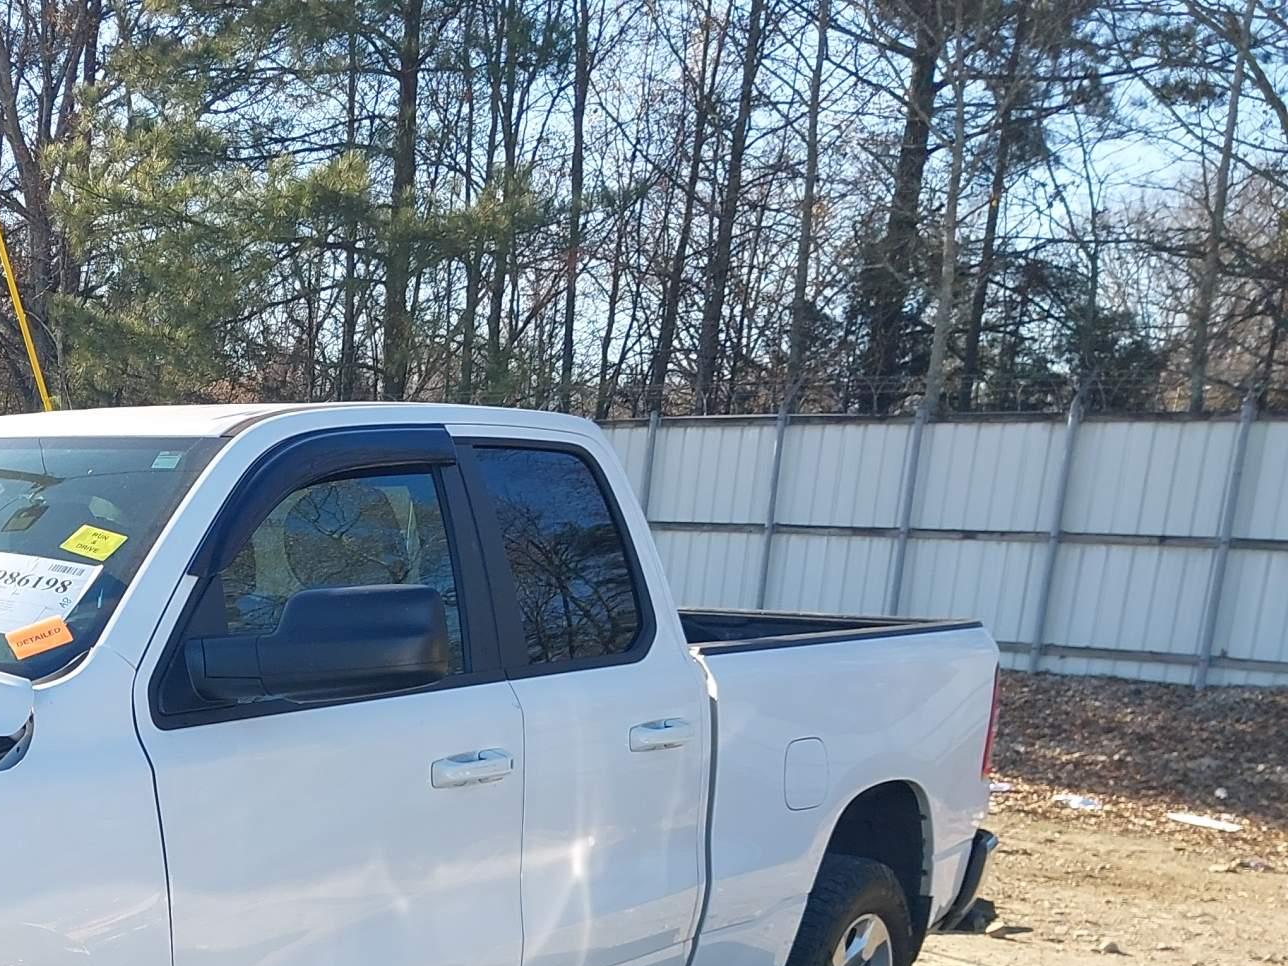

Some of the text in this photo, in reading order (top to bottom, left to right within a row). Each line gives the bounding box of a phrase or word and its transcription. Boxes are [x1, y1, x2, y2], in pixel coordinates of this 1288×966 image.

[91, 532, 110, 541] RUN
[75, 543, 99, 554] DRIVE
[16, 627, 61, 647] DETAILED
